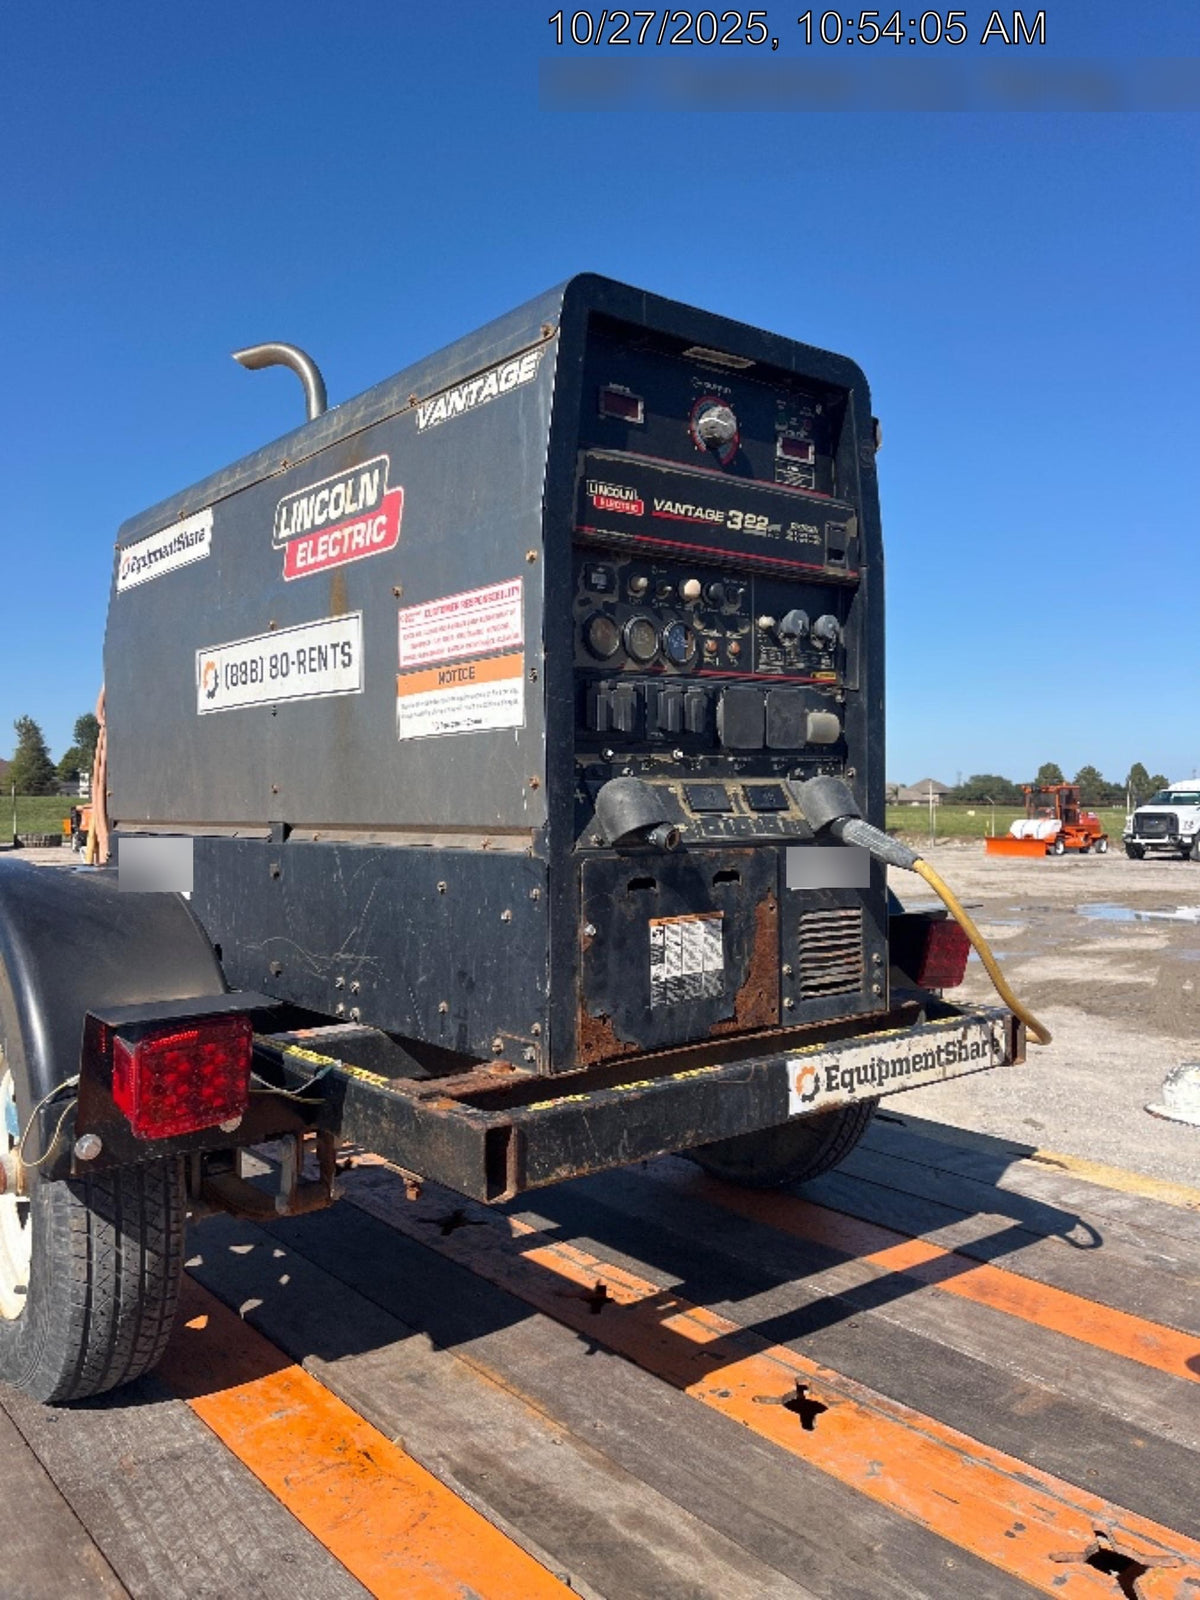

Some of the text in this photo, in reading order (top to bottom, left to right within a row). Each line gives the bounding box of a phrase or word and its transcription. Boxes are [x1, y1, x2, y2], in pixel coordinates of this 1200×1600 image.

[416, 353, 541, 432] VANTAGE
[278, 468, 381, 540] LINCOLN
[589, 482, 635, 501] LINCOLN
[653, 497, 769, 532] VANTAGE 322
[295, 513, 388, 568] ELECTRIC
[224, 640, 353, 690] (888) 80-RENTS
[438, 665, 476, 685] NOTICE
[824, 1036, 1000, 1094] EquipmentShare
